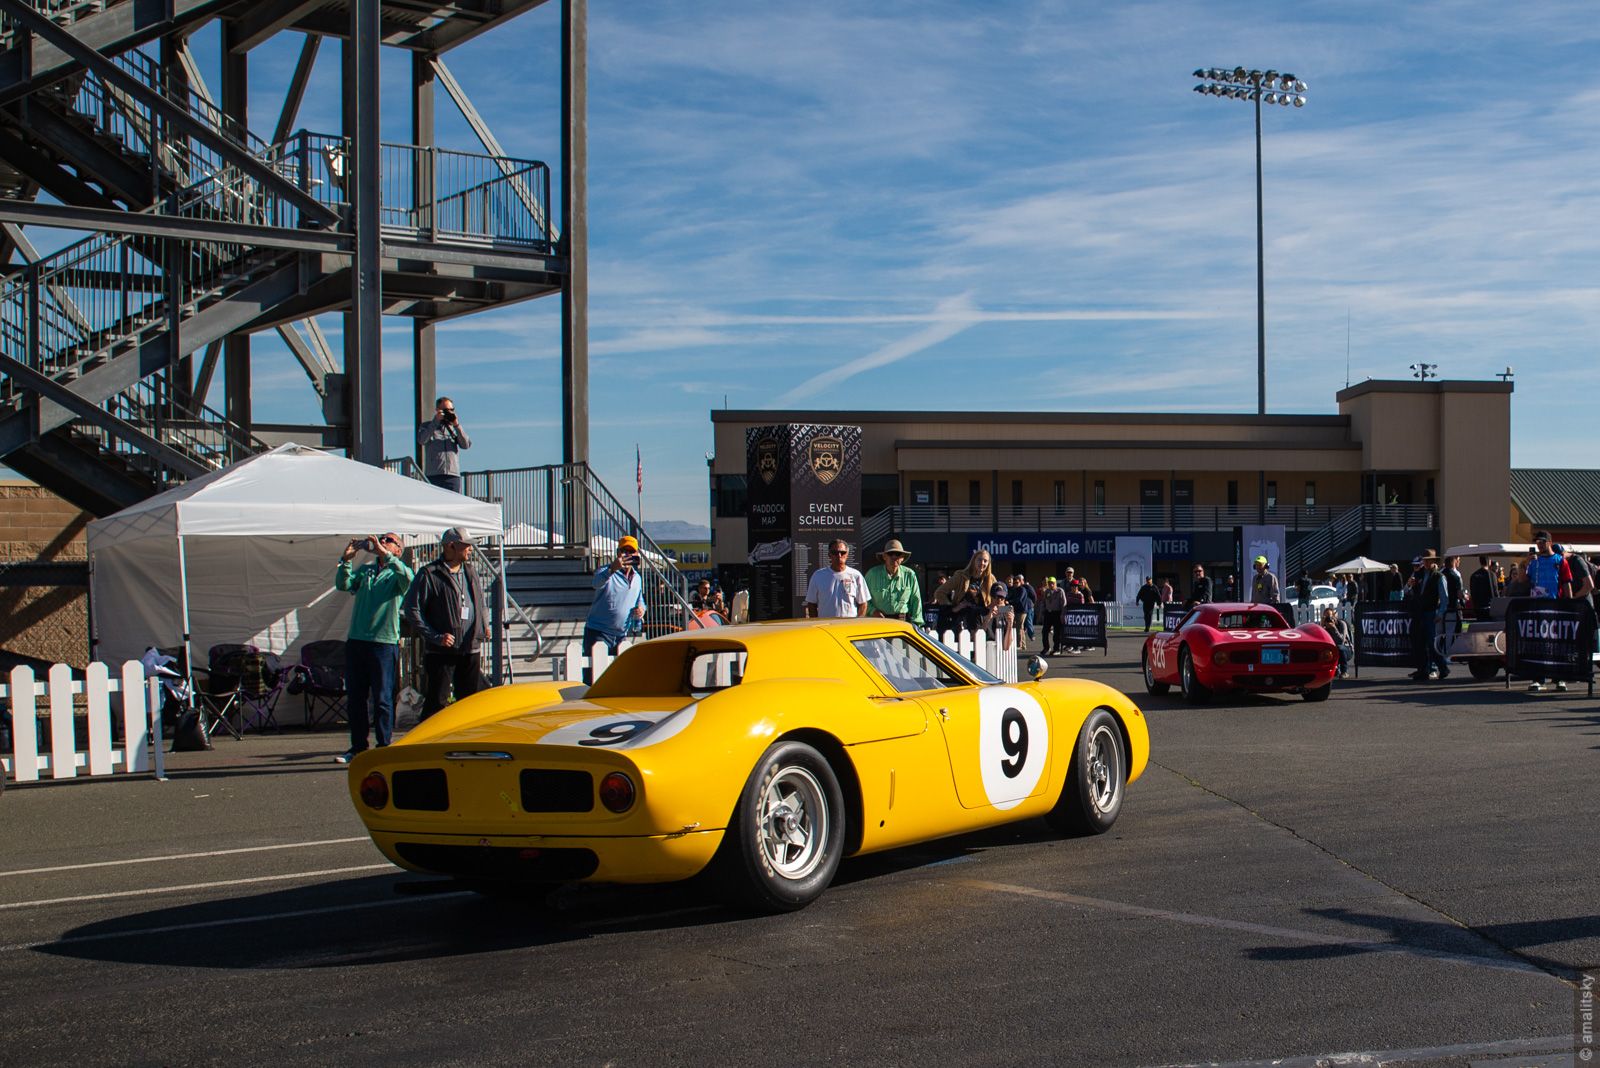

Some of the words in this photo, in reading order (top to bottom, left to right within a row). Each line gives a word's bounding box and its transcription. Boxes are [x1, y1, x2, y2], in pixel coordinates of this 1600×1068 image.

[752, 504, 786, 514] PADDOCK
[809, 503, 844, 513] EVENT
[761, 516, 777, 526] MAP
[799, 515, 854, 525] SCHEDULE
[973, 540, 1008, 555] John
[1012, 540, 1080, 554] Cardinale
[680, 552, 709, 563] NEW
[1064, 614, 1099, 626] VELOCITY
[1361, 618, 1412, 636] VELOCITY
[1517, 619, 1580, 640] VELOCITY
[1227, 629, 1302, 640] 526
[1152, 638, 1167, 669] 526
[578, 720, 655, 746] 9
[1000, 707, 1029, 779] 9
